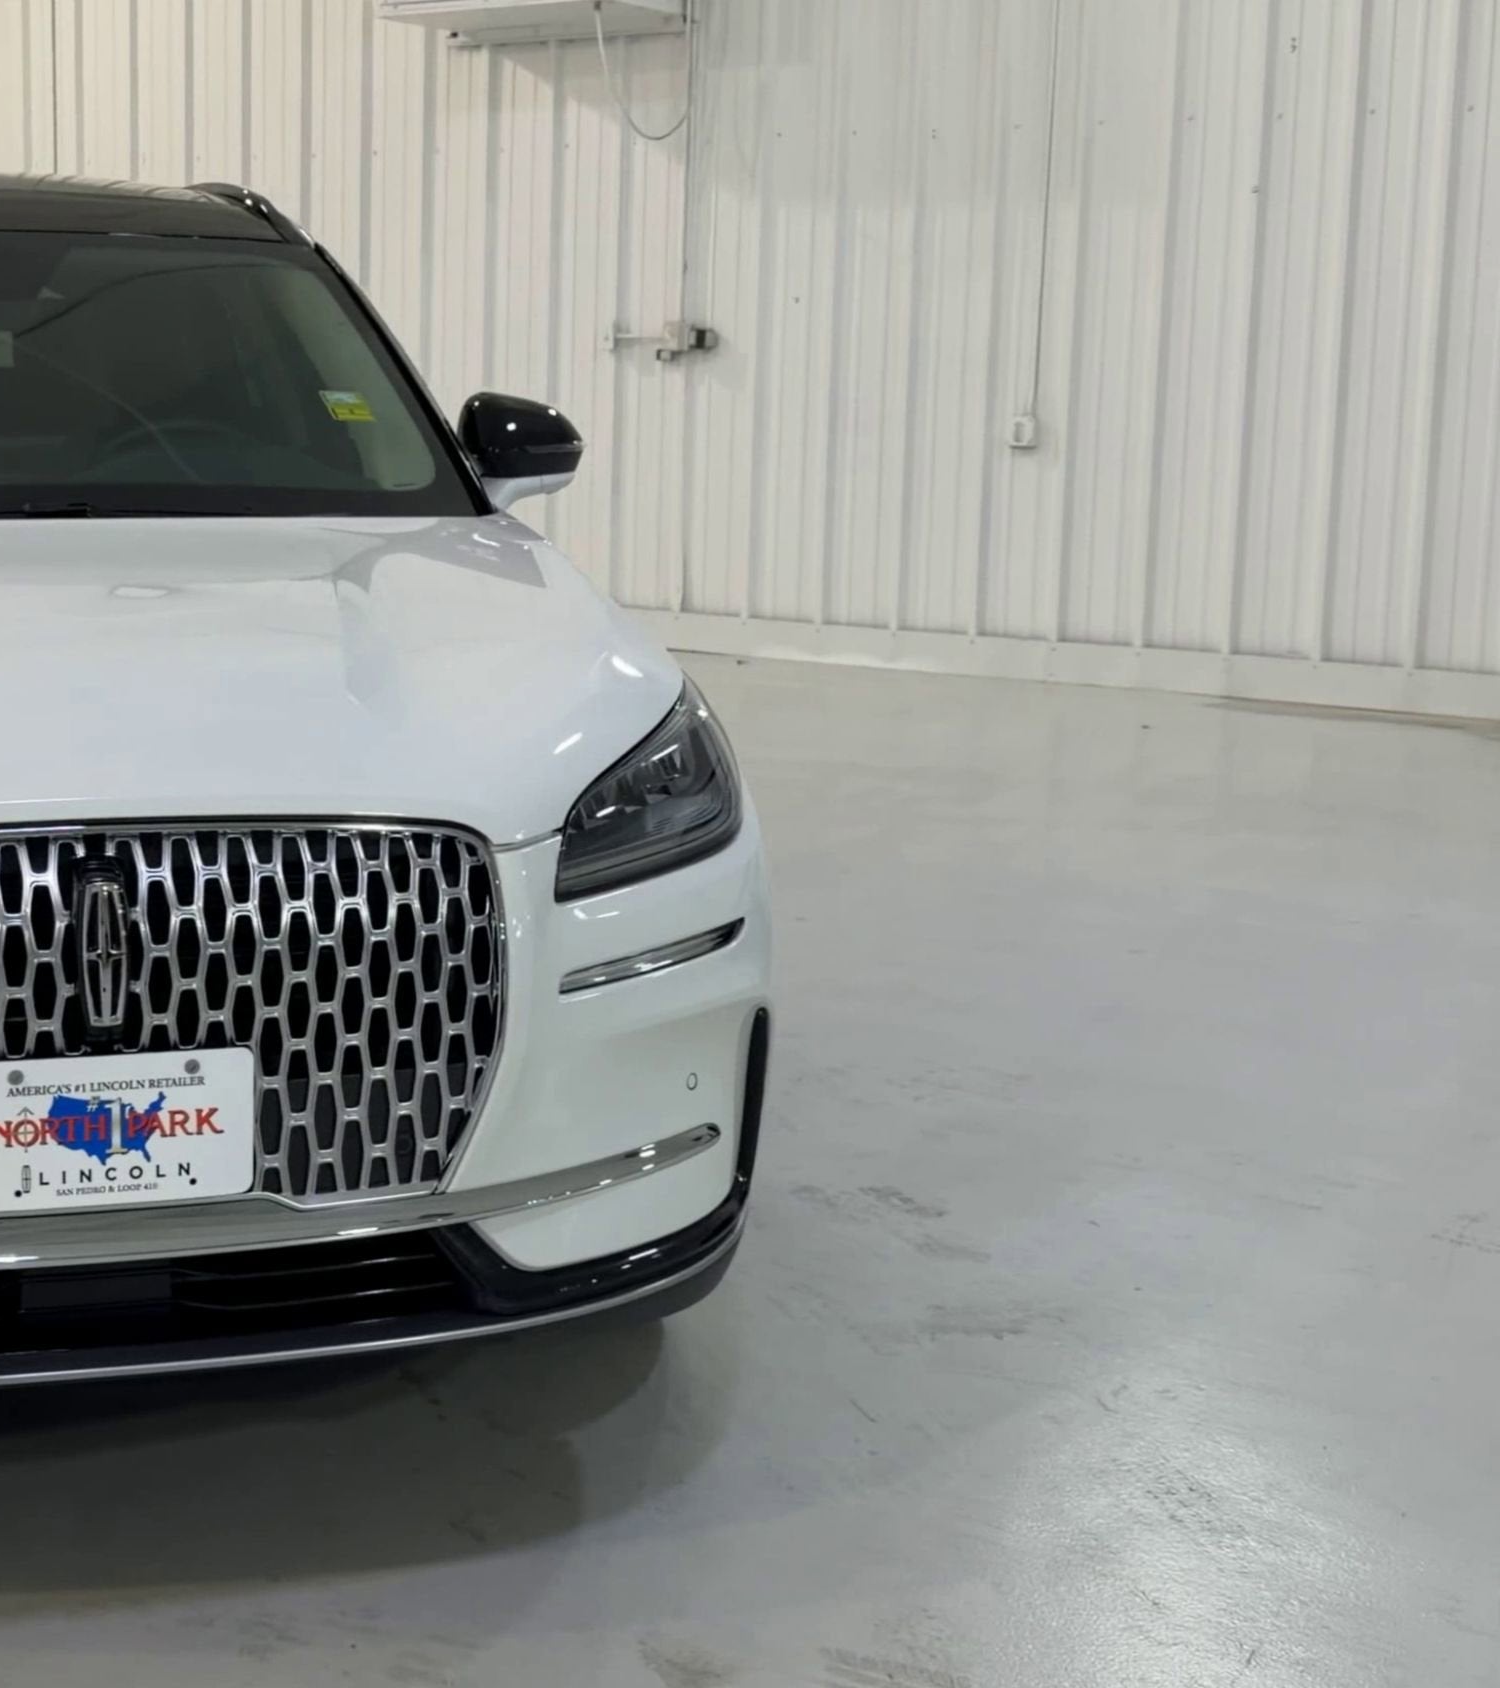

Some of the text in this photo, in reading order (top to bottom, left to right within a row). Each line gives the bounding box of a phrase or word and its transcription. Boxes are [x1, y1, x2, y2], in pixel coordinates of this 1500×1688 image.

[6, 1084, 72, 1098] AMERICA'S
[90, 1079, 146, 1093] LINCOLN
[148, 1075, 206, 1089] RETAILER
[127, 1107, 225, 1141] PARK
[39, 1162, 191, 1186] LINCOLN
[56, 1188, 74, 1196] SAN
[118, 1183, 142, 1192] LOOP
